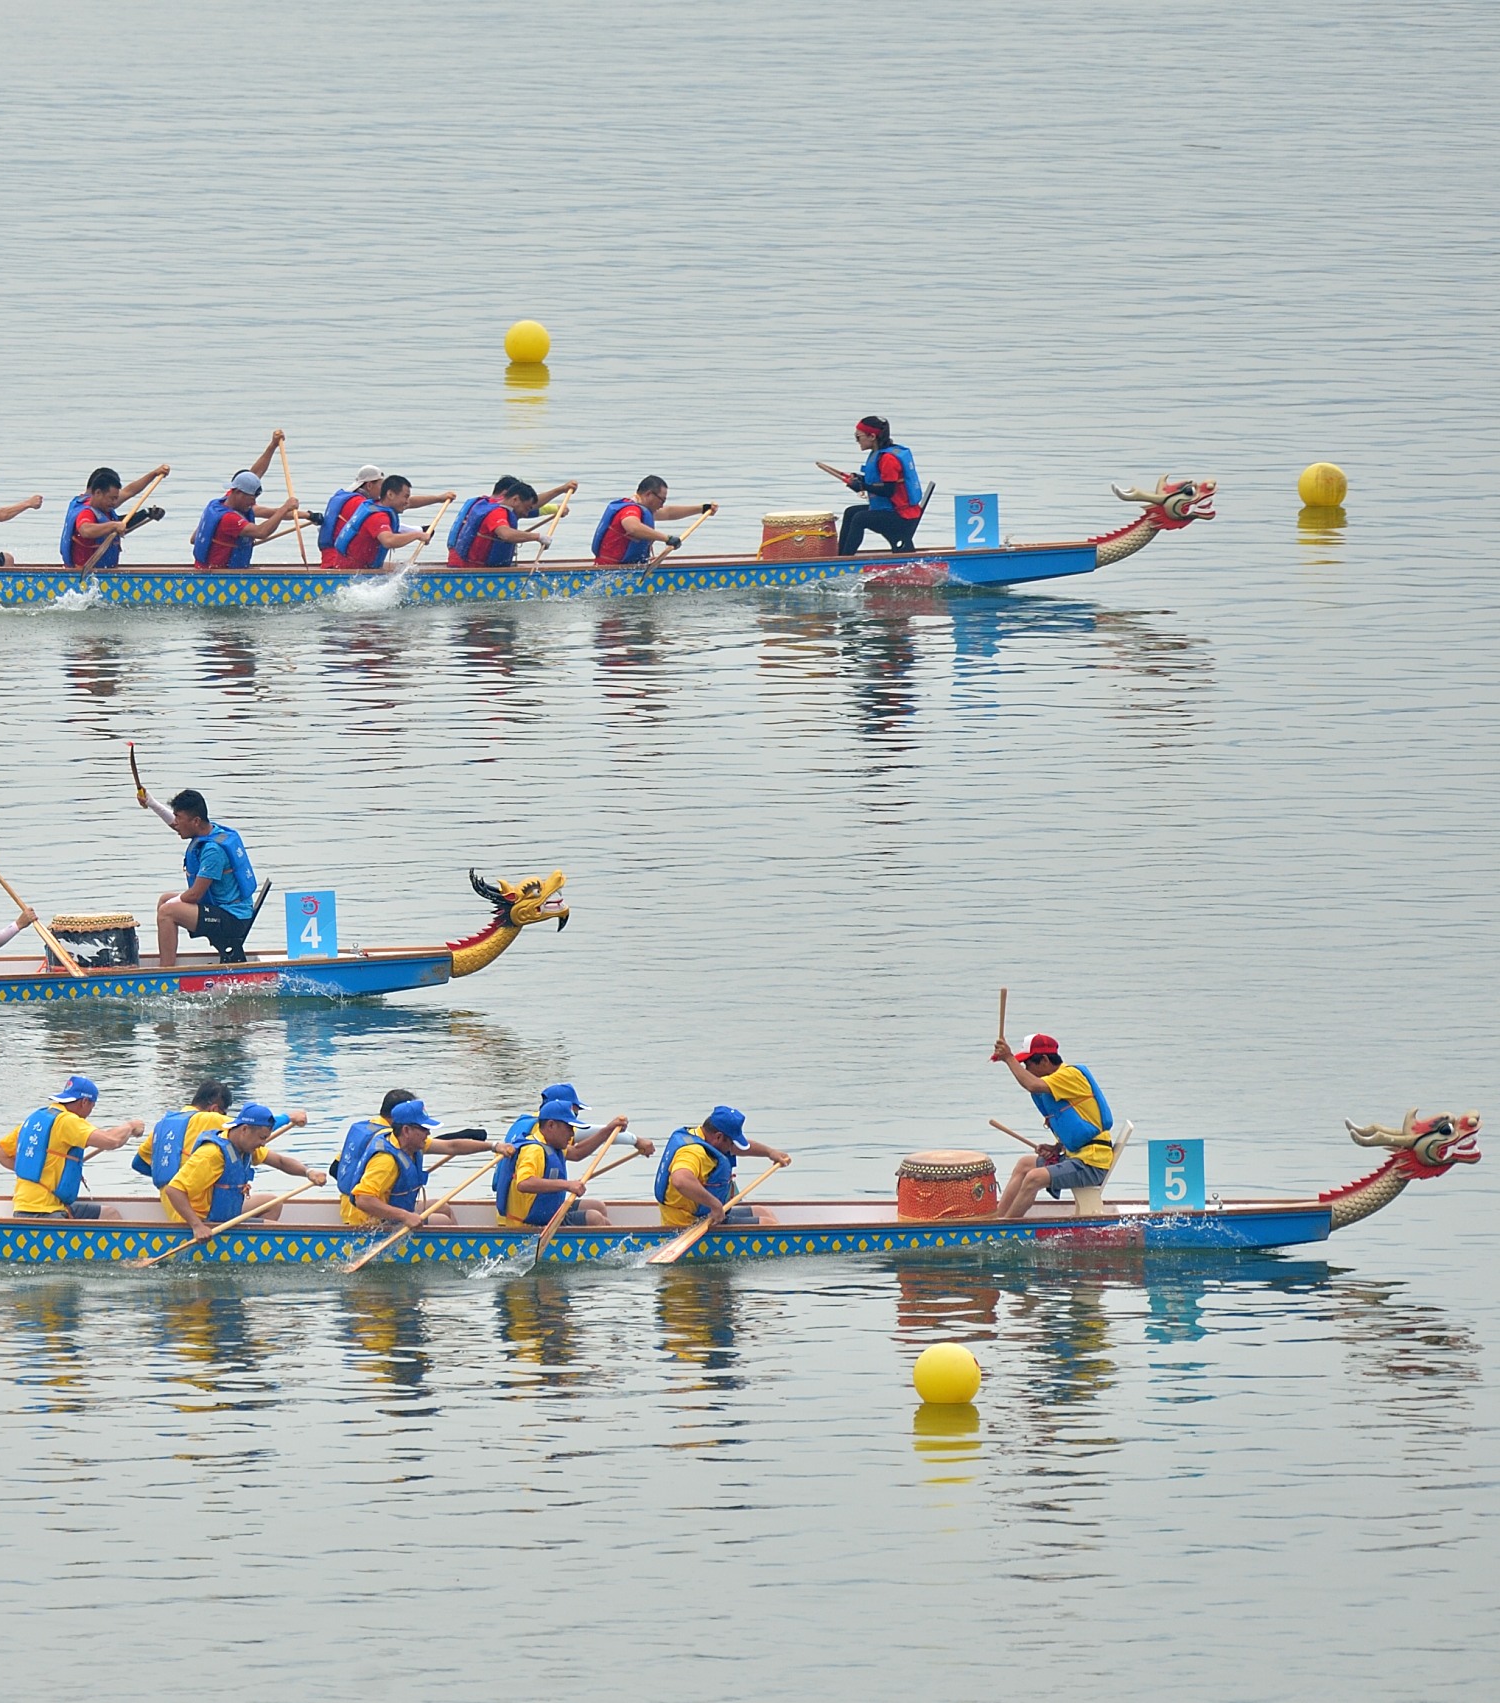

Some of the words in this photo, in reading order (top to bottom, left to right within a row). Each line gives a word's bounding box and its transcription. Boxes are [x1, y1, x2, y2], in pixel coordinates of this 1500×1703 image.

[967, 515, 986, 543] 2
[300, 917, 323, 949] 4
[1164, 1166, 1188, 1201] 5
